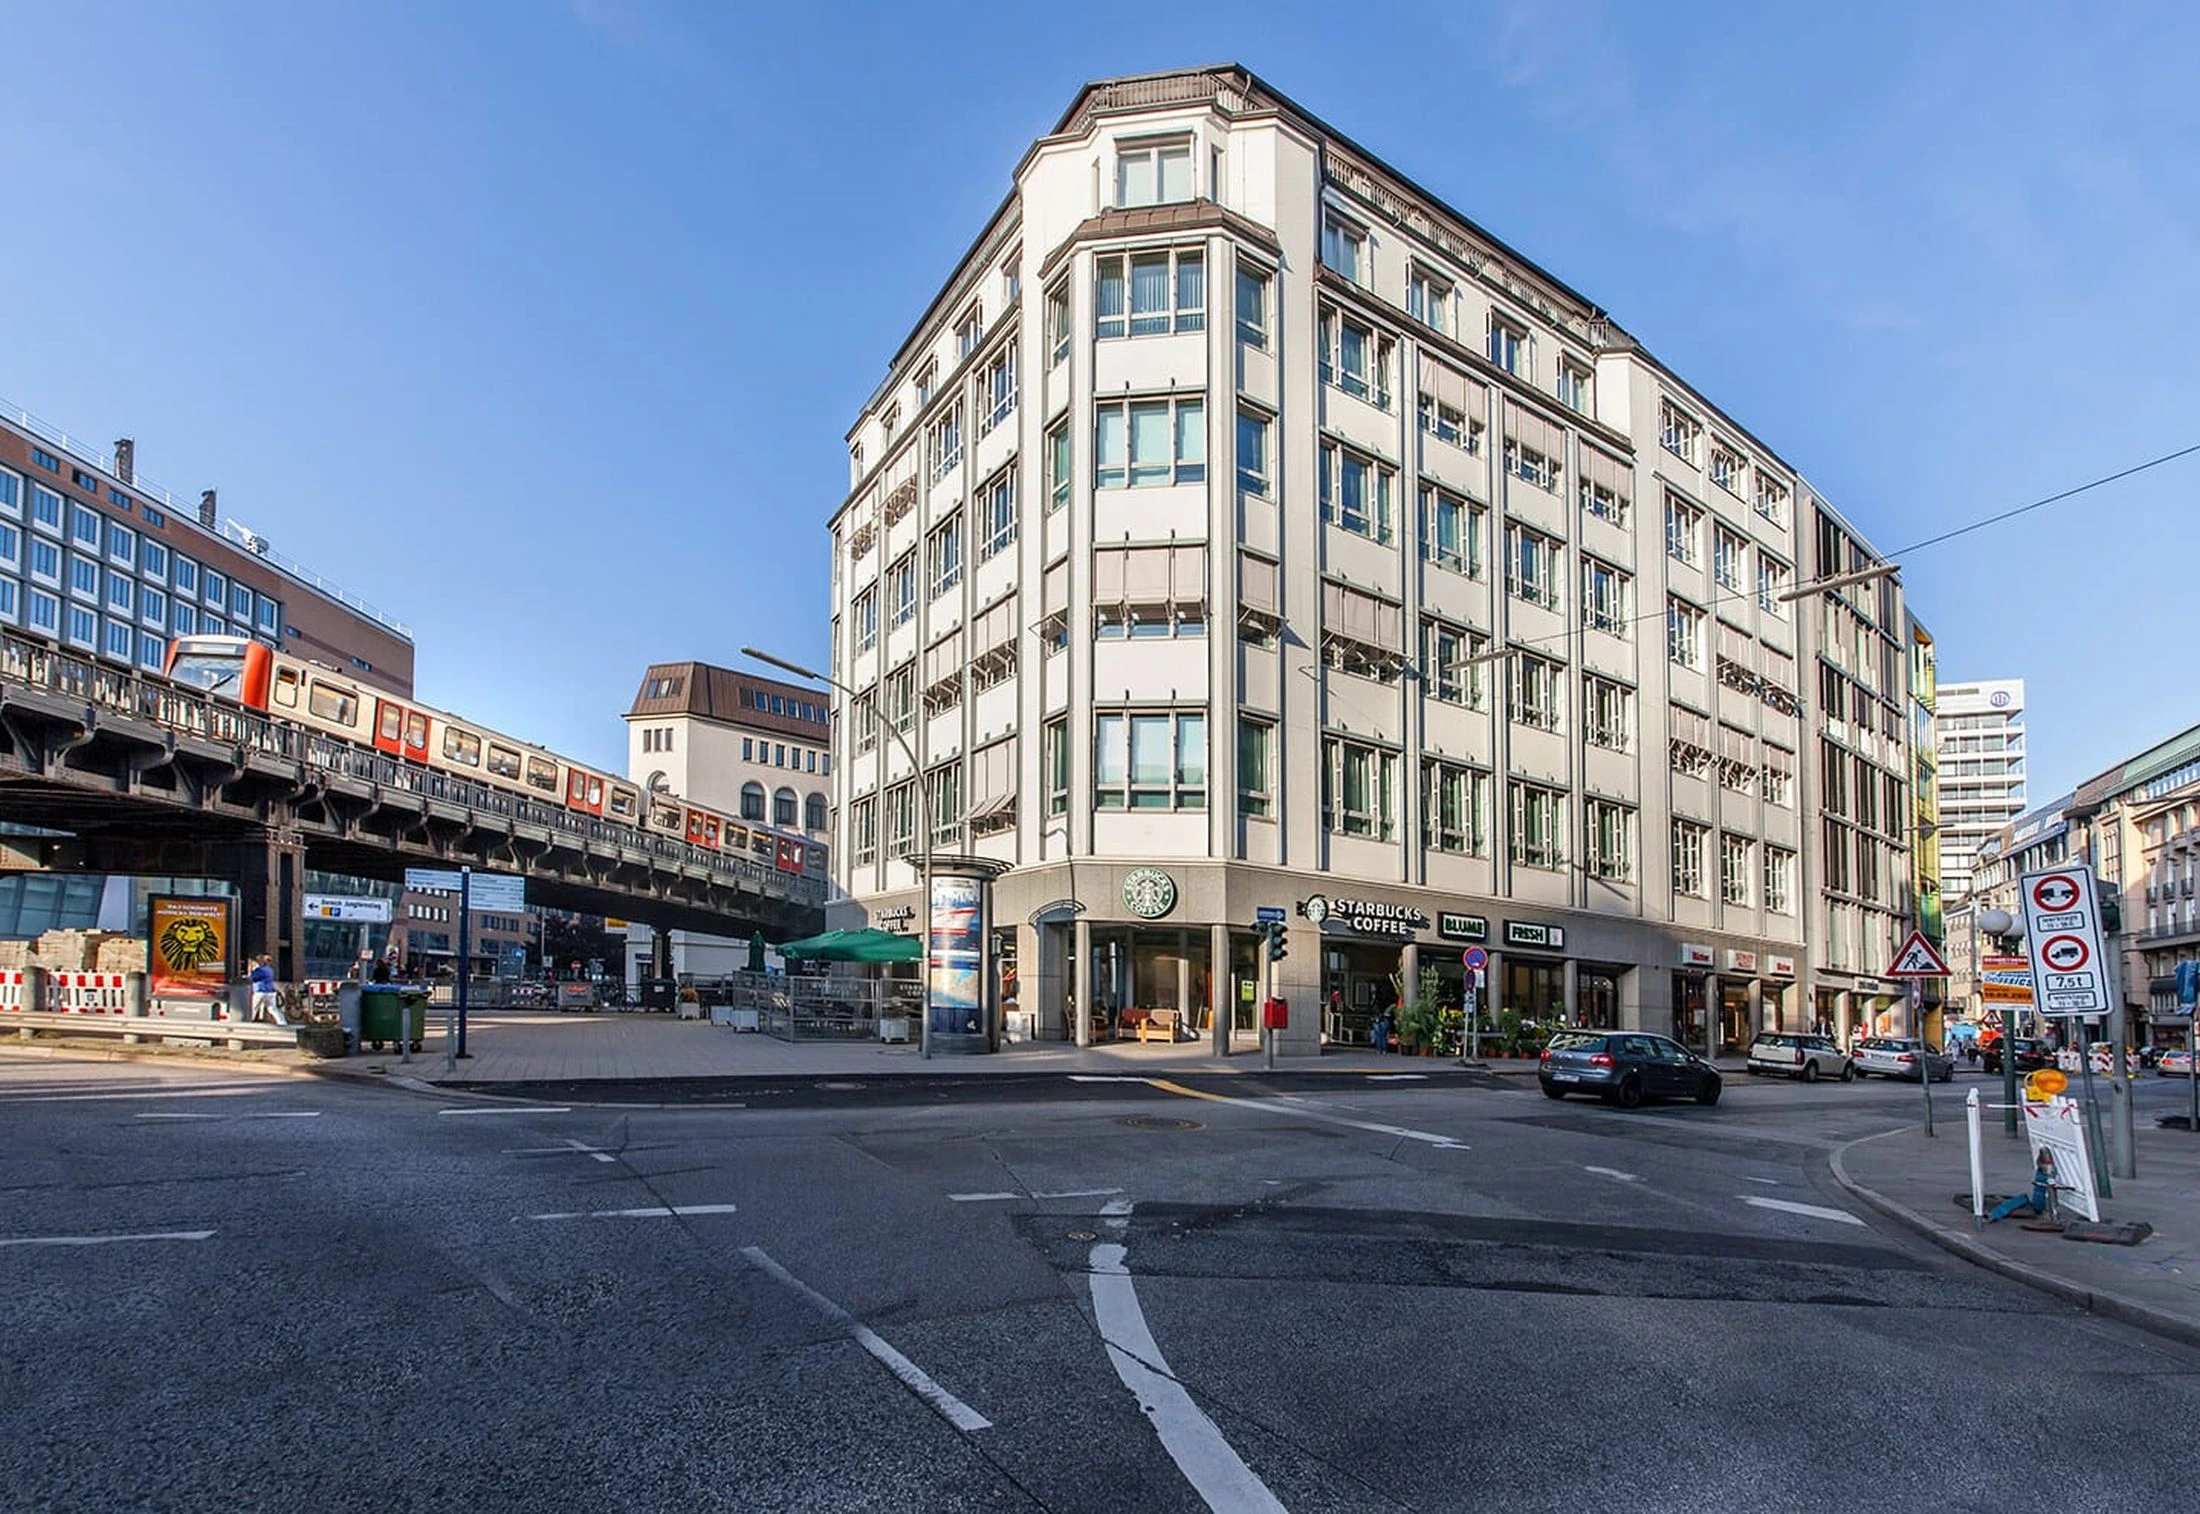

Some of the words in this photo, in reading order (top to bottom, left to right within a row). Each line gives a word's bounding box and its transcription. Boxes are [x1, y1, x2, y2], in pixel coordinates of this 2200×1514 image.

[1337, 898, 1421, 921] STARBUCKS
[1353, 916, 1407, 935] COFFEE
[1445, 918, 1483, 935] BLUME
[2055, 975, 2076, 988] 7,5
[2077, 976, 2082, 987] t
